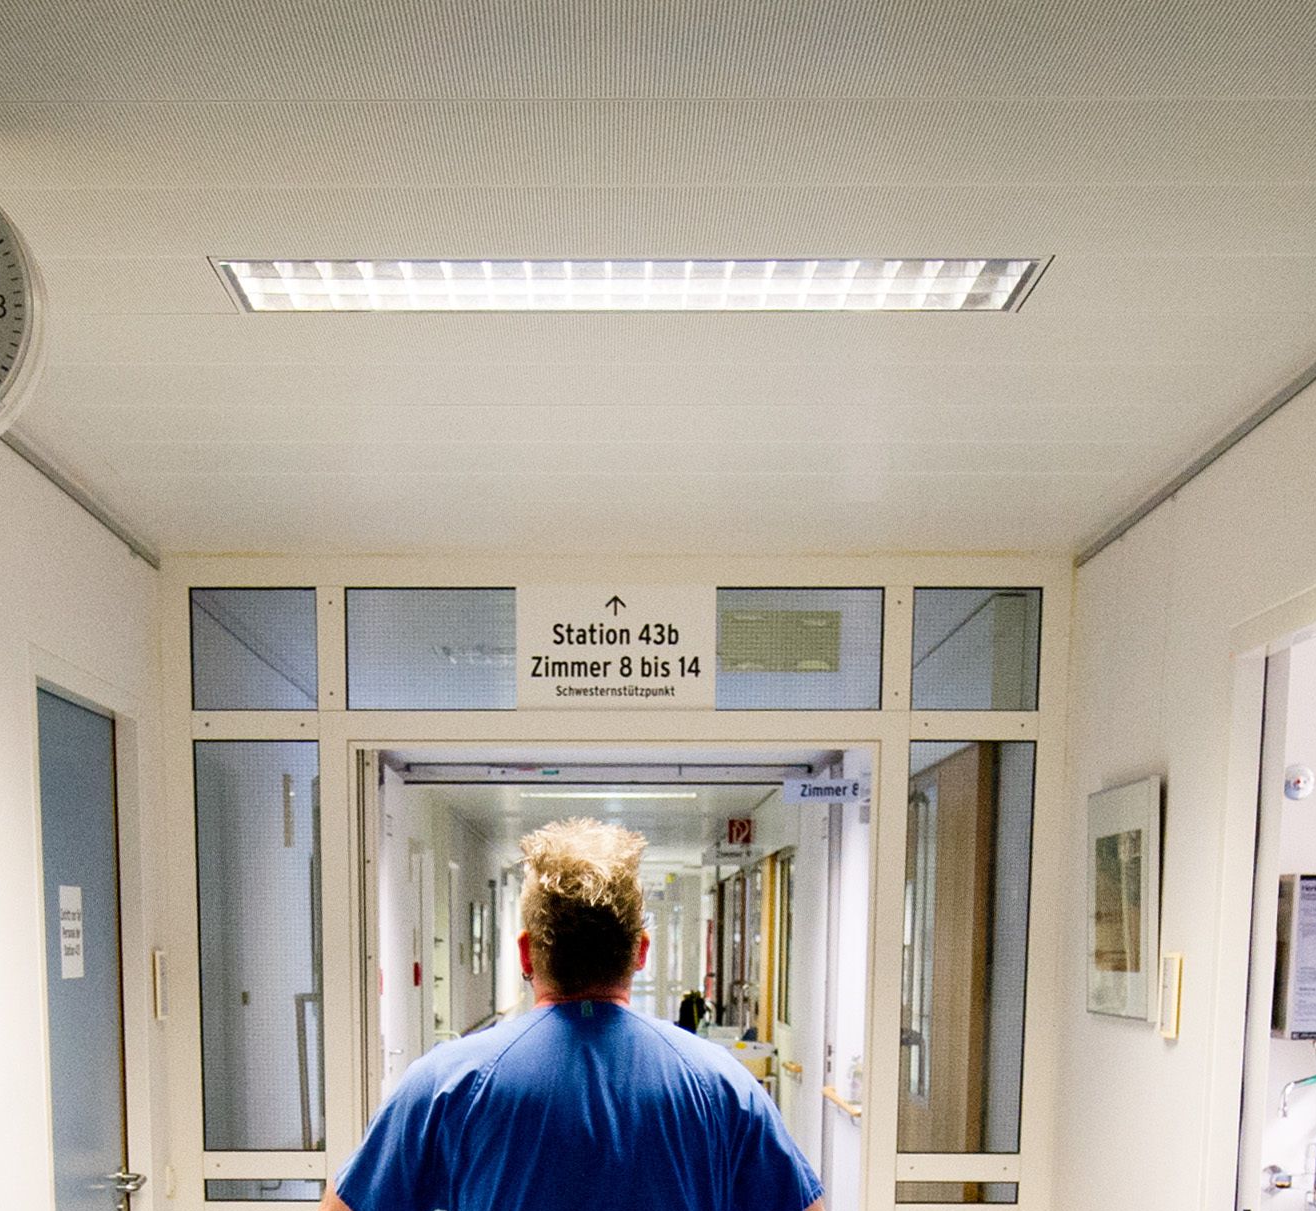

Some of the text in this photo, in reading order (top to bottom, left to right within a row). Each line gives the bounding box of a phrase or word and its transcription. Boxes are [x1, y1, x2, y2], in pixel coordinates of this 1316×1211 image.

[552, 623, 680, 646] Station 43b
[530, 655, 701, 678] Zimmer 8 bis 14
[555, 684, 676, 698] Schwesternstützpunkt
[800, 783, 848, 798] Zimmer
